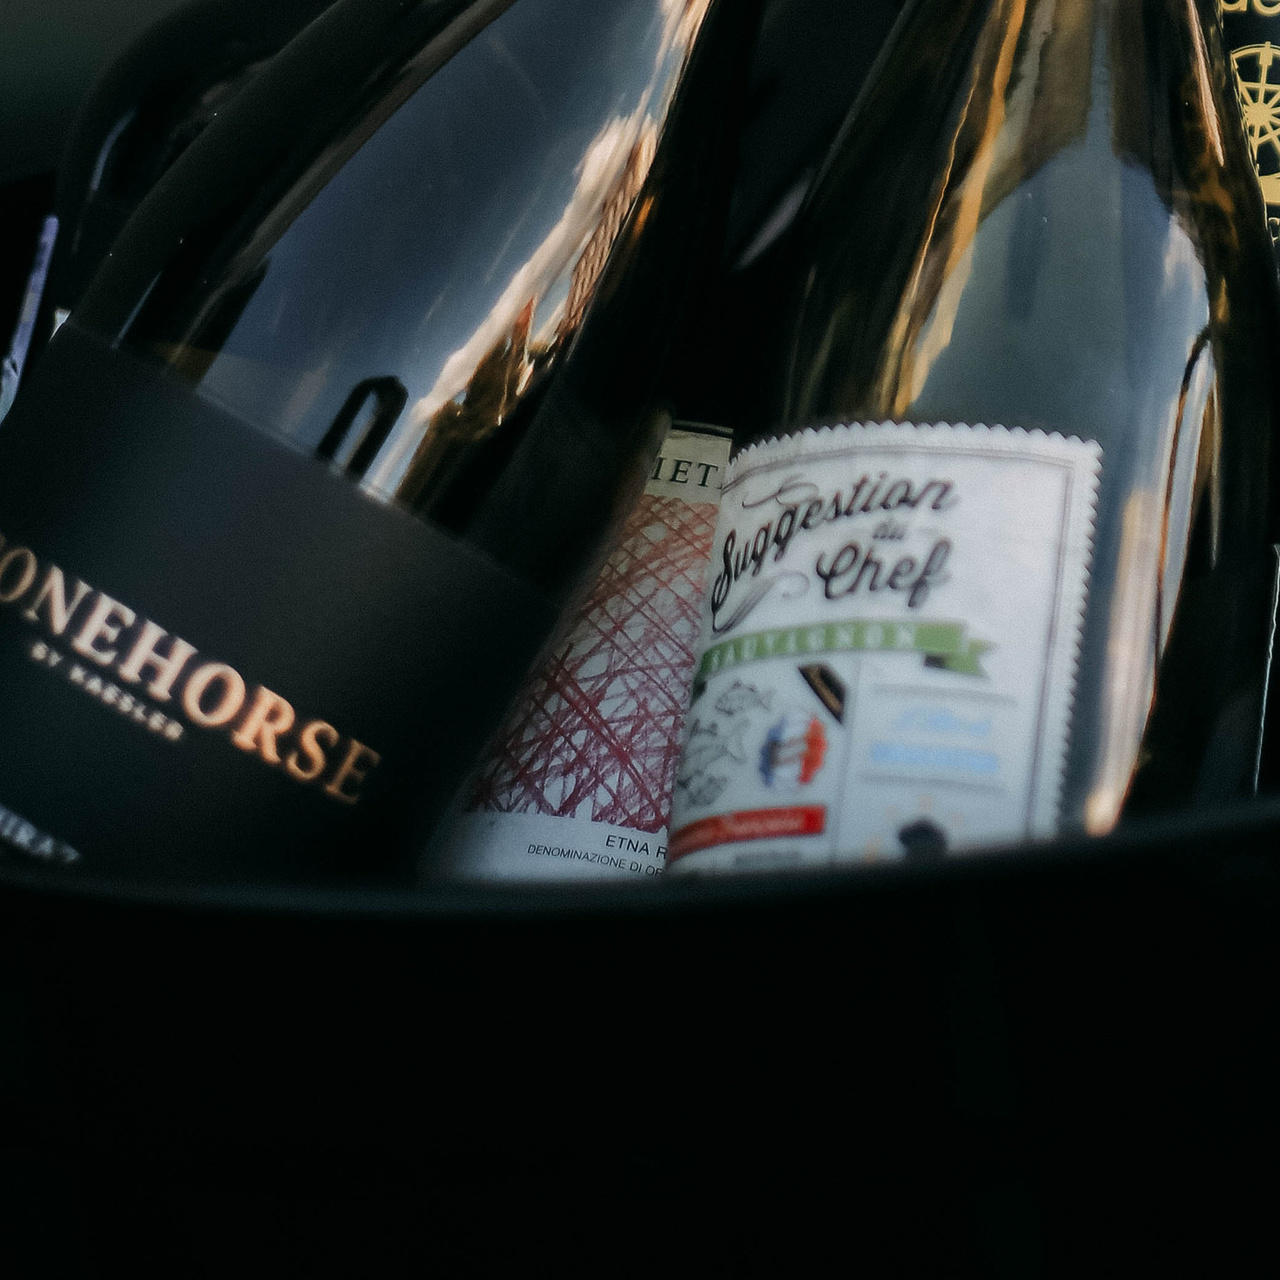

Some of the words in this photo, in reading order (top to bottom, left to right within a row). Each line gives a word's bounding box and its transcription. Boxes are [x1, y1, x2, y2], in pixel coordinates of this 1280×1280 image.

[711, 470, 957, 633] Suggestion
[816, 538, 952, 608] Chef
[526, 843, 627, 870] DENOMINAZIONE
[629, 860, 643, 875] DI
[605, 834, 651, 856] ETNA
